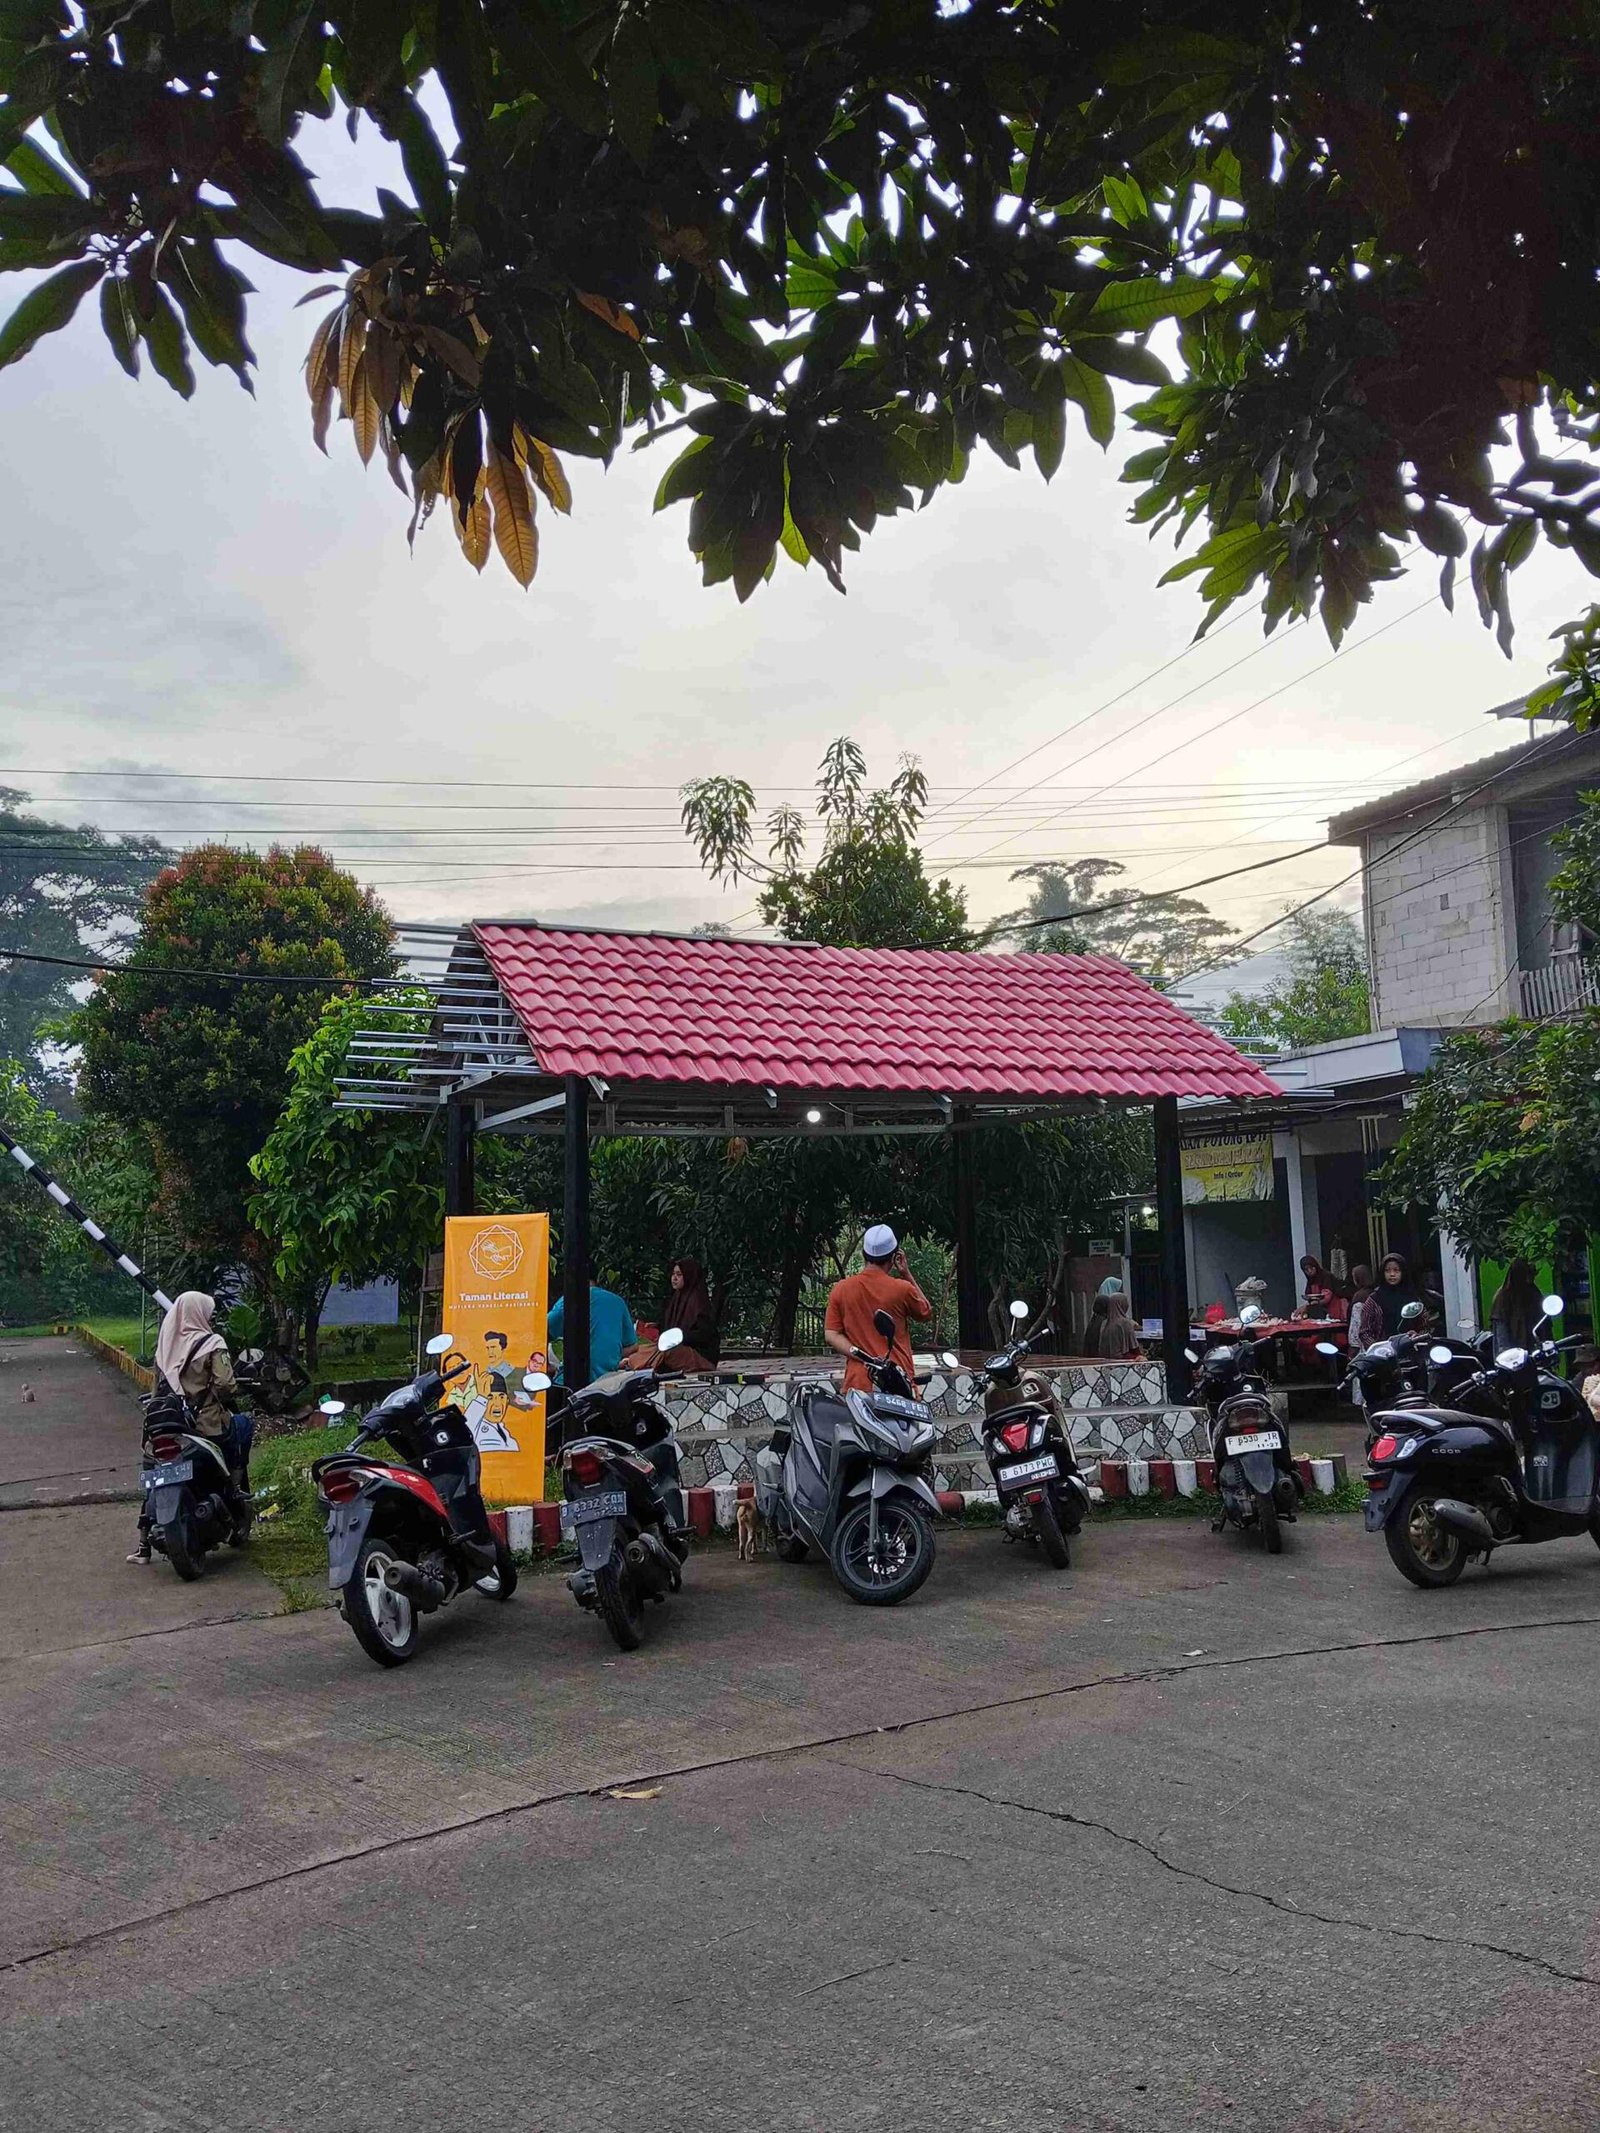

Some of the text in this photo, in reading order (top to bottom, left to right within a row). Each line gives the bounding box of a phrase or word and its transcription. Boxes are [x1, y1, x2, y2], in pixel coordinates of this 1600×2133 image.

[460, 1291, 529, 1302] Taman Literasi
[1228, 1437, 1234, 1446] F
[1001, 1457, 1053, 1480] B 6173 PWG
